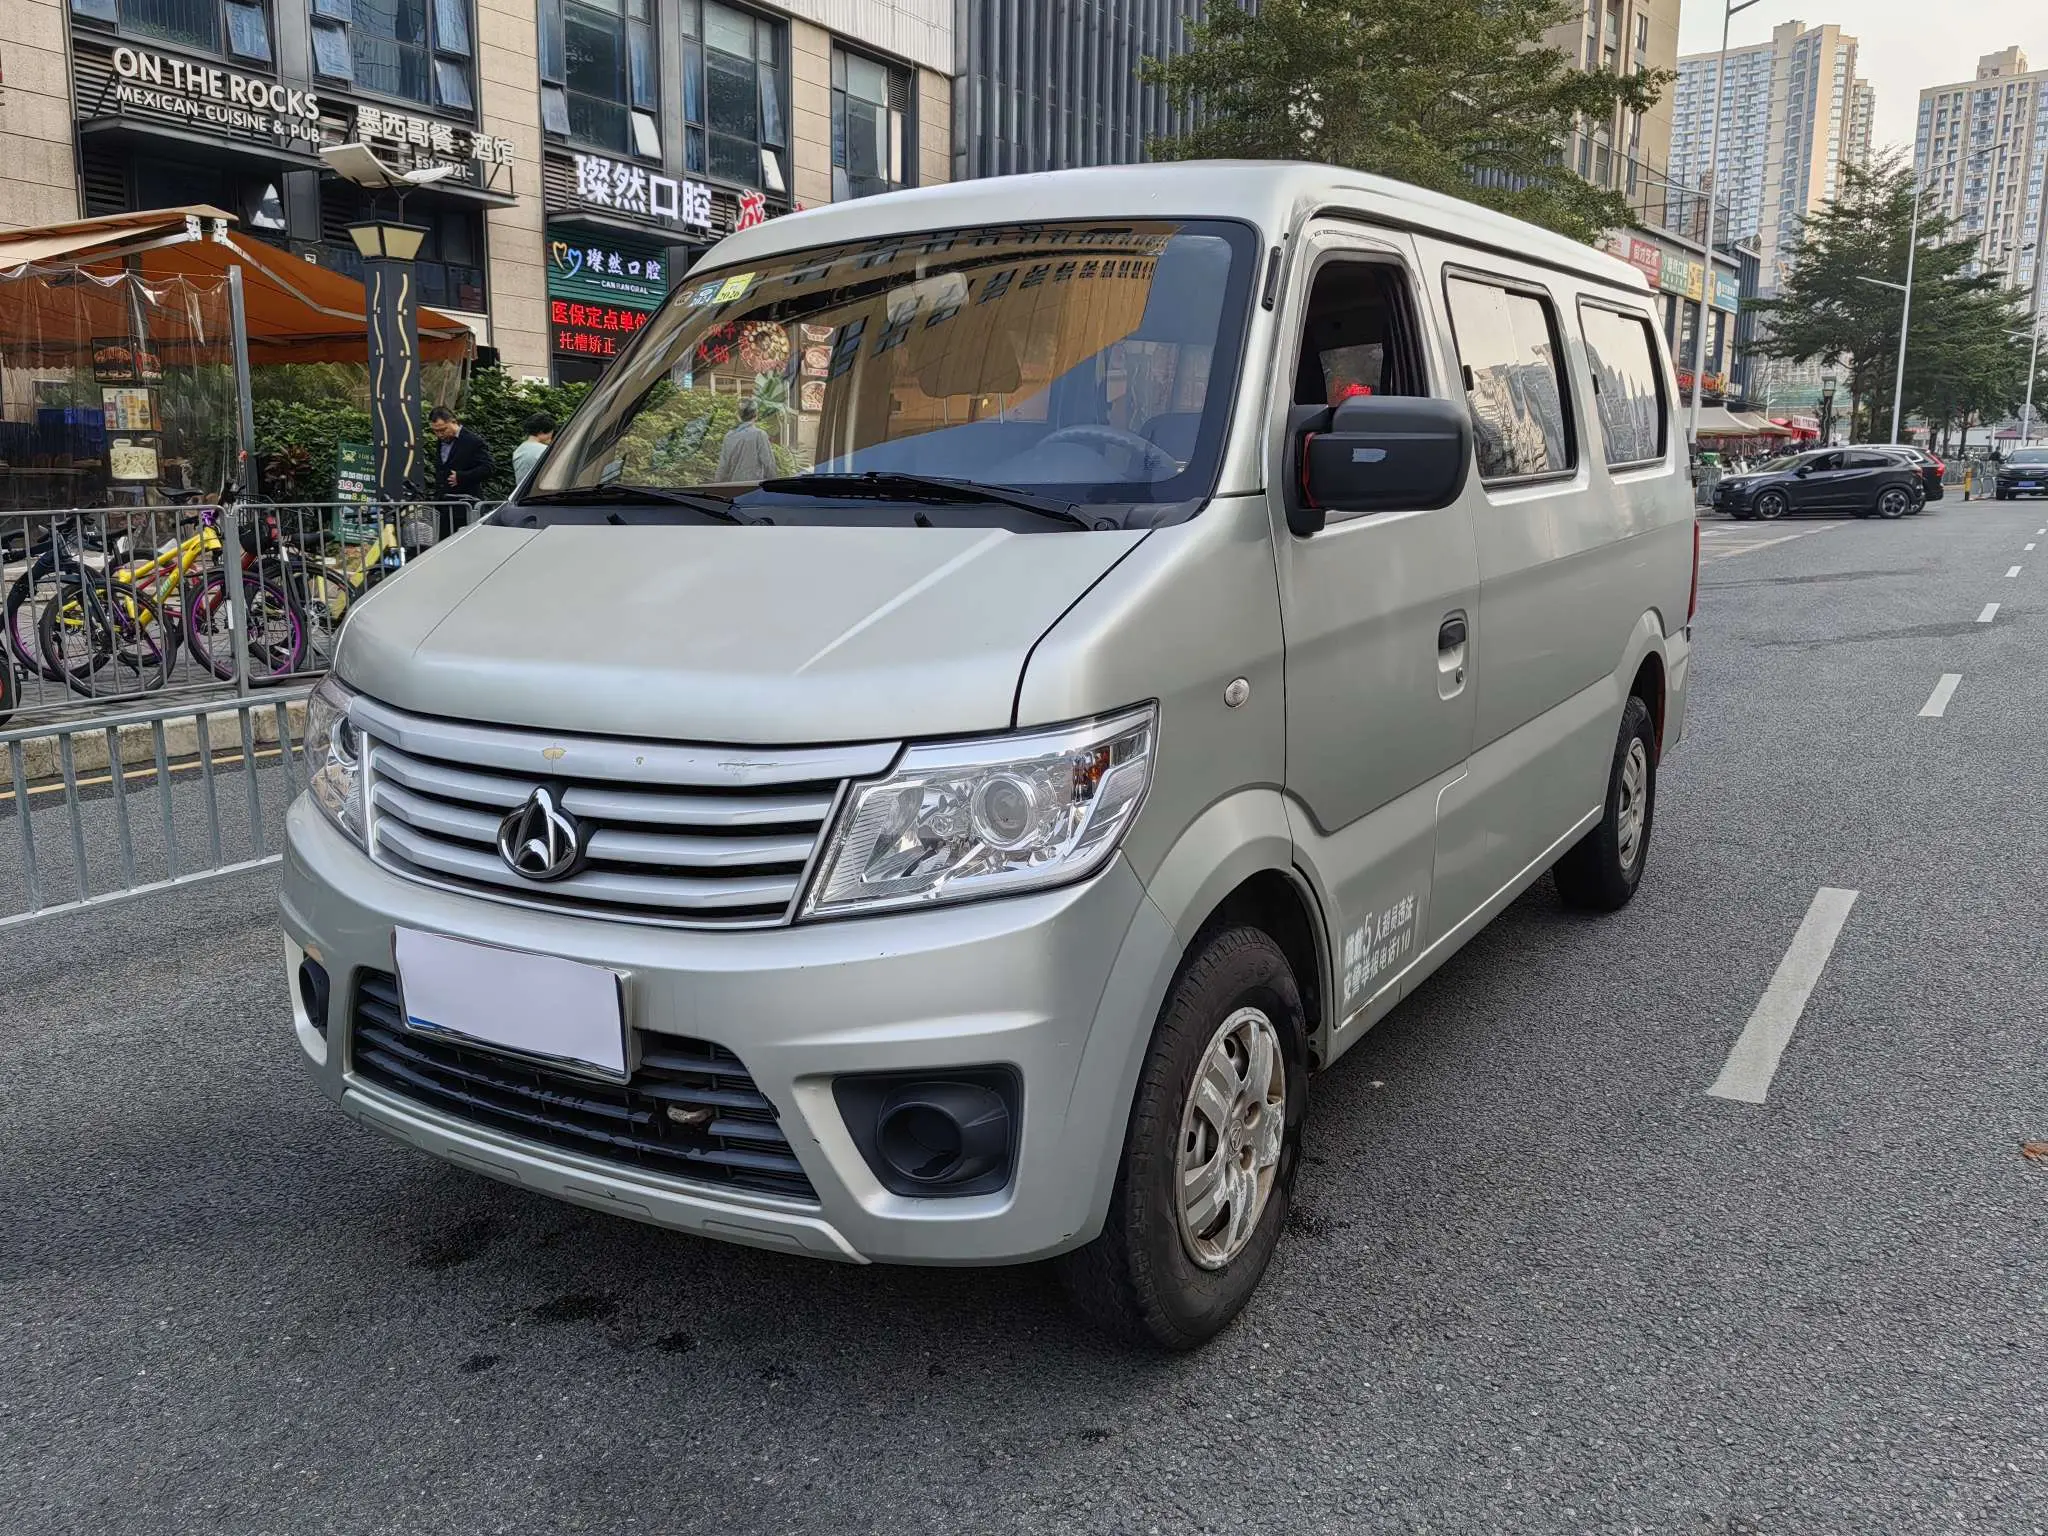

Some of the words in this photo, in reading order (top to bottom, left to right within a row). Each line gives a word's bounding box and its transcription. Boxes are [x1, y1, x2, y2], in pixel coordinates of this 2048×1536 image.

[114, 47, 161, 84] ON
[168, 59, 224, 98] THE
[230, 74, 319, 120] ROCKS
[116, 85, 198, 116] MEXICAN
[205, 105, 267, 132] CUISINE
[273, 120, 284, 135] &
[291, 124, 319, 143] PUB
[575, 155, 712, 228] 璨然口腔
[586, 248, 662, 280] 璨然口腔
[559, 330, 616, 354] 托槽矫正
